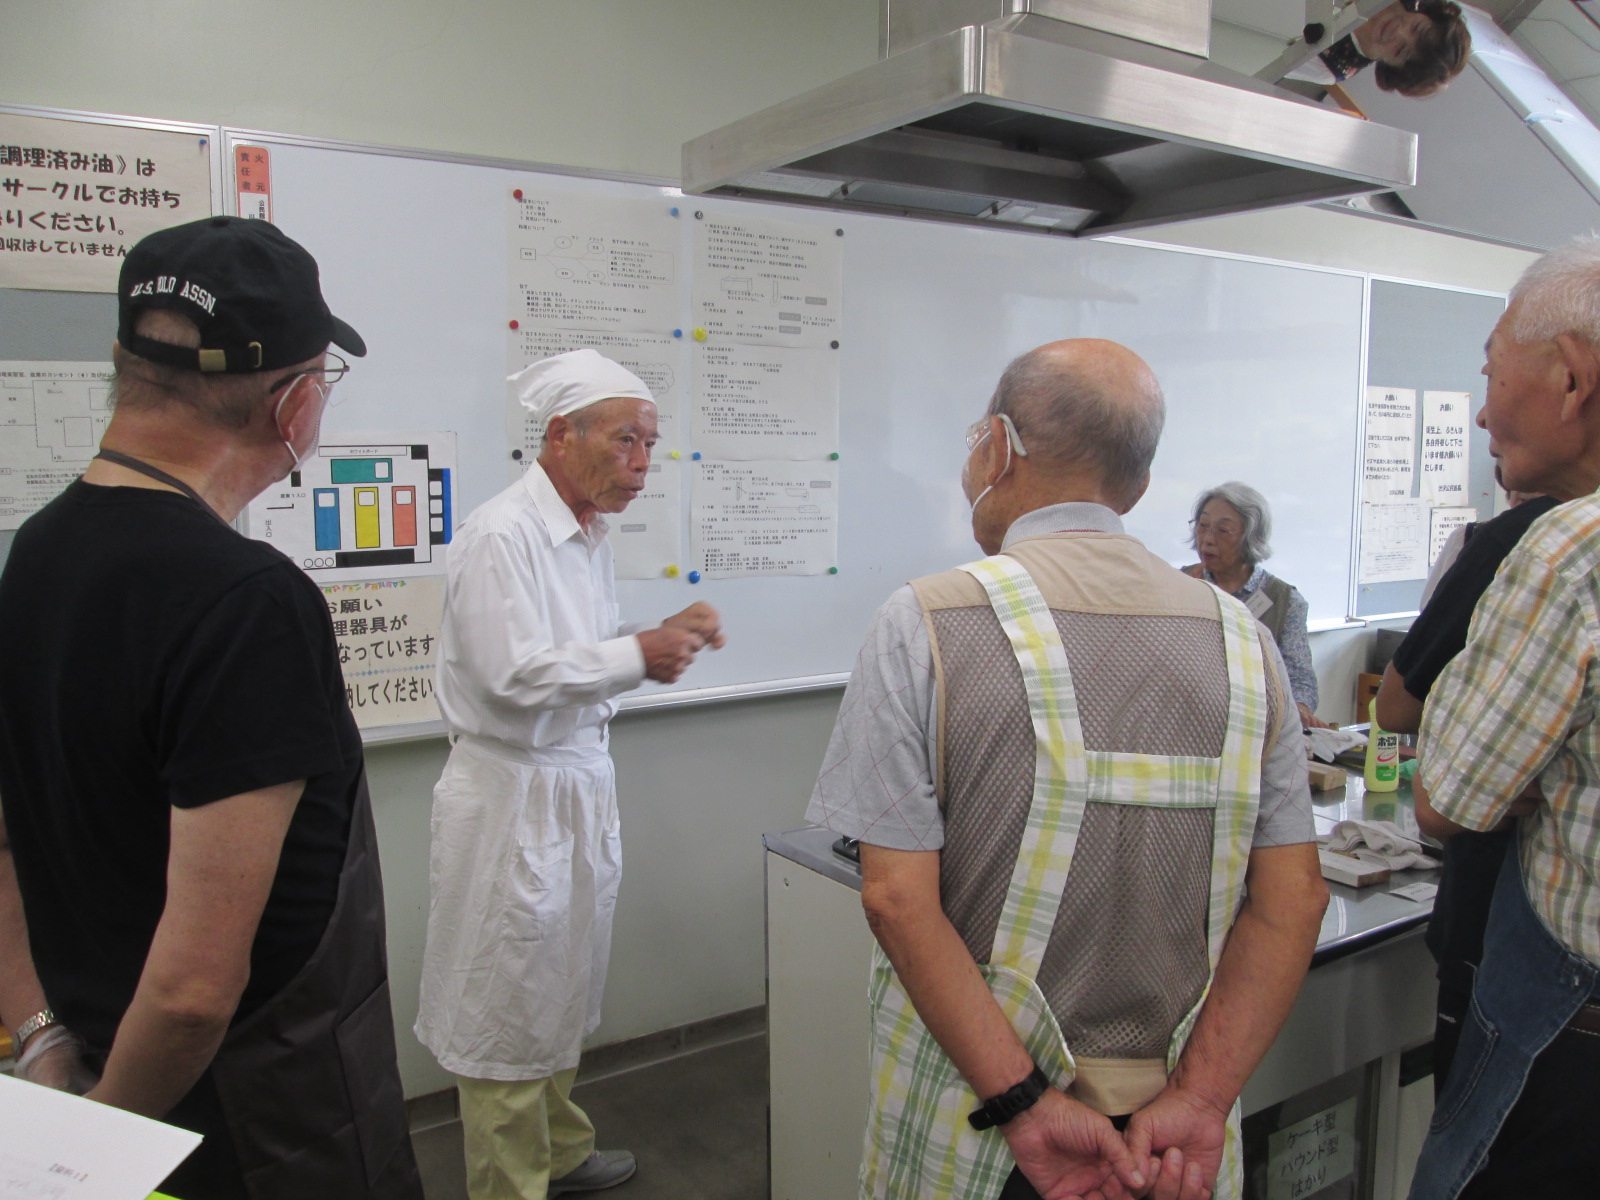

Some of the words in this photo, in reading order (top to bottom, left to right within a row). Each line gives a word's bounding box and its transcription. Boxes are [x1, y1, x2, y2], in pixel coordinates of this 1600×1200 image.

[2, 178, 181, 209] サークルでお持ち
[0, 238, 134, 258] 収はしていません
[180, 280, 217, 317] ASSN.
[265, 519, 273, 538] 出入口
[338, 634, 435, 664] なっています
[1291, 1165, 1327, 1199] はかり
